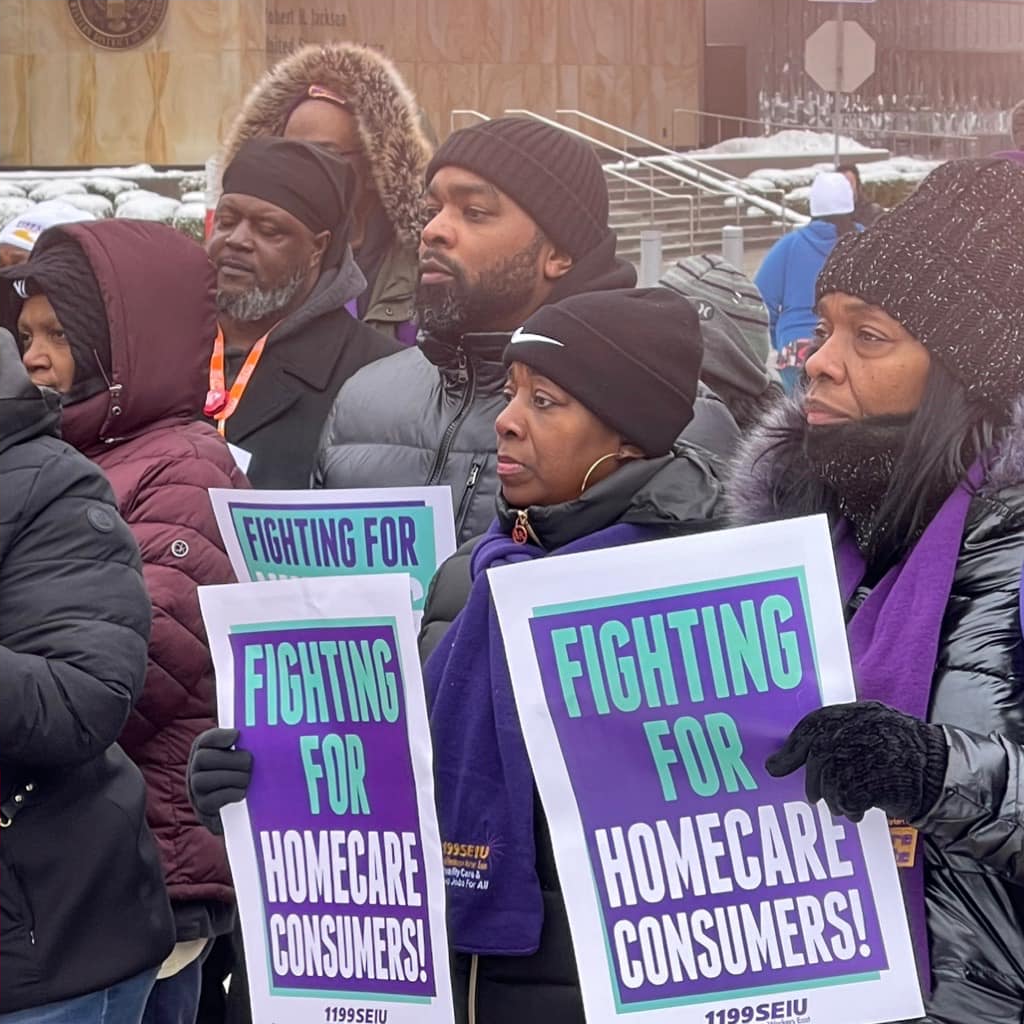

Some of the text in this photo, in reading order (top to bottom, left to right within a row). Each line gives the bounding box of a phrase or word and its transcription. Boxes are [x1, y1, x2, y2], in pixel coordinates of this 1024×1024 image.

[242, 515, 419, 568] FIGHTING FOR
[244, 637, 400, 727] FIGHTING
[550, 593, 803, 719] FIGHTING
[300, 733, 371, 816] FOR
[643, 711, 758, 801] FOR
[260, 829, 422, 907] HOMECARE
[477, 880, 489, 890] All
[594, 798, 855, 909] HOMECARE
[270, 913, 428, 982] CONSUMERS!
[613, 888, 872, 990] CONSUMERS!
[324, 1006, 387, 1024] 1199SEIU
[705, 998, 808, 1024] 1199SEIU
